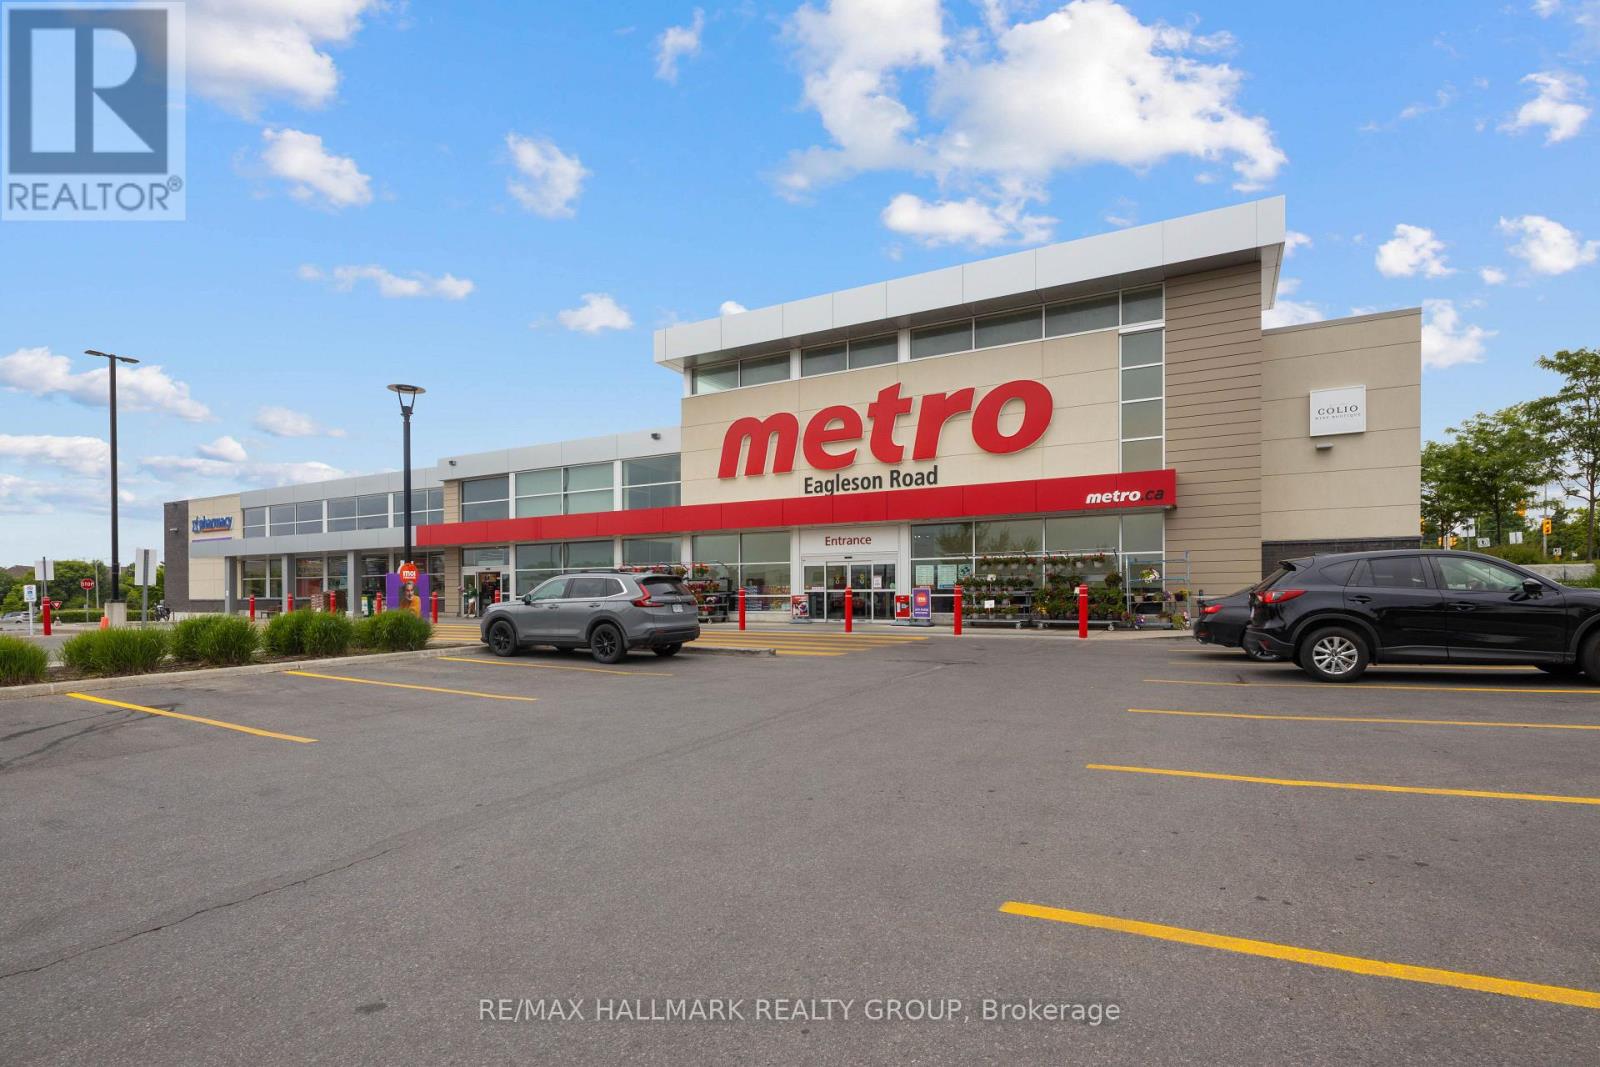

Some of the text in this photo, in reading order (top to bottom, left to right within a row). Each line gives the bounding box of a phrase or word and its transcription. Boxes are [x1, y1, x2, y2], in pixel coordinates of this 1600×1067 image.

[1317, 404, 1359, 416] COLIO
[718, 379, 1053, 479] metro
[804, 464, 939, 496] Eagleson Road
[1085, 489, 1164, 504] metro.ca
[825, 535, 872, 546] Entrance
